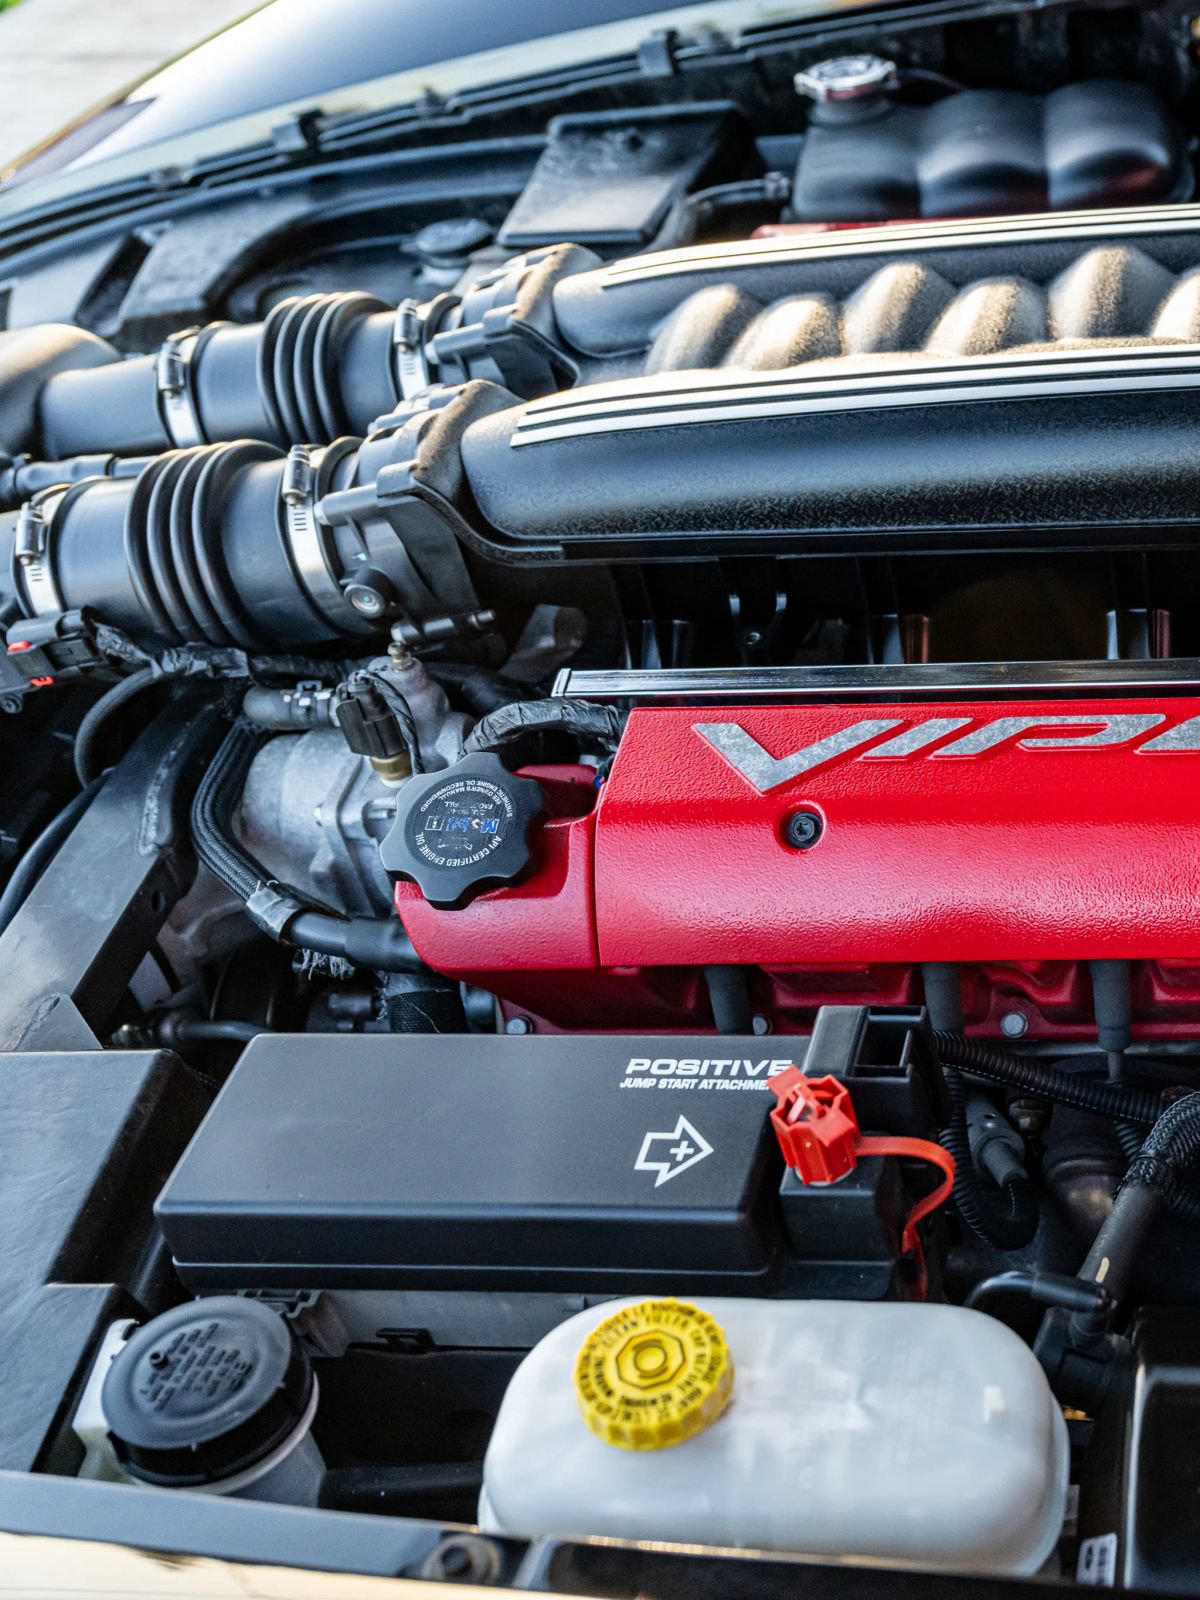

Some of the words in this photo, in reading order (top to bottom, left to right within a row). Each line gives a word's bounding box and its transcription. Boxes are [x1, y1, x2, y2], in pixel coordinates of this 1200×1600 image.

[414, 832, 424, 846] OIL
[487, 834, 502, 850] API
[420, 844, 445, 865] ENGINE
[445, 847, 489, 866] CERTIFIED
[625, 1058, 793, 1076] POSITIVE
[620, 1078, 657, 1088] JUMP
[658, 1078, 696, 1089] START
[698, 1079, 768, 1090] ATTACHME
